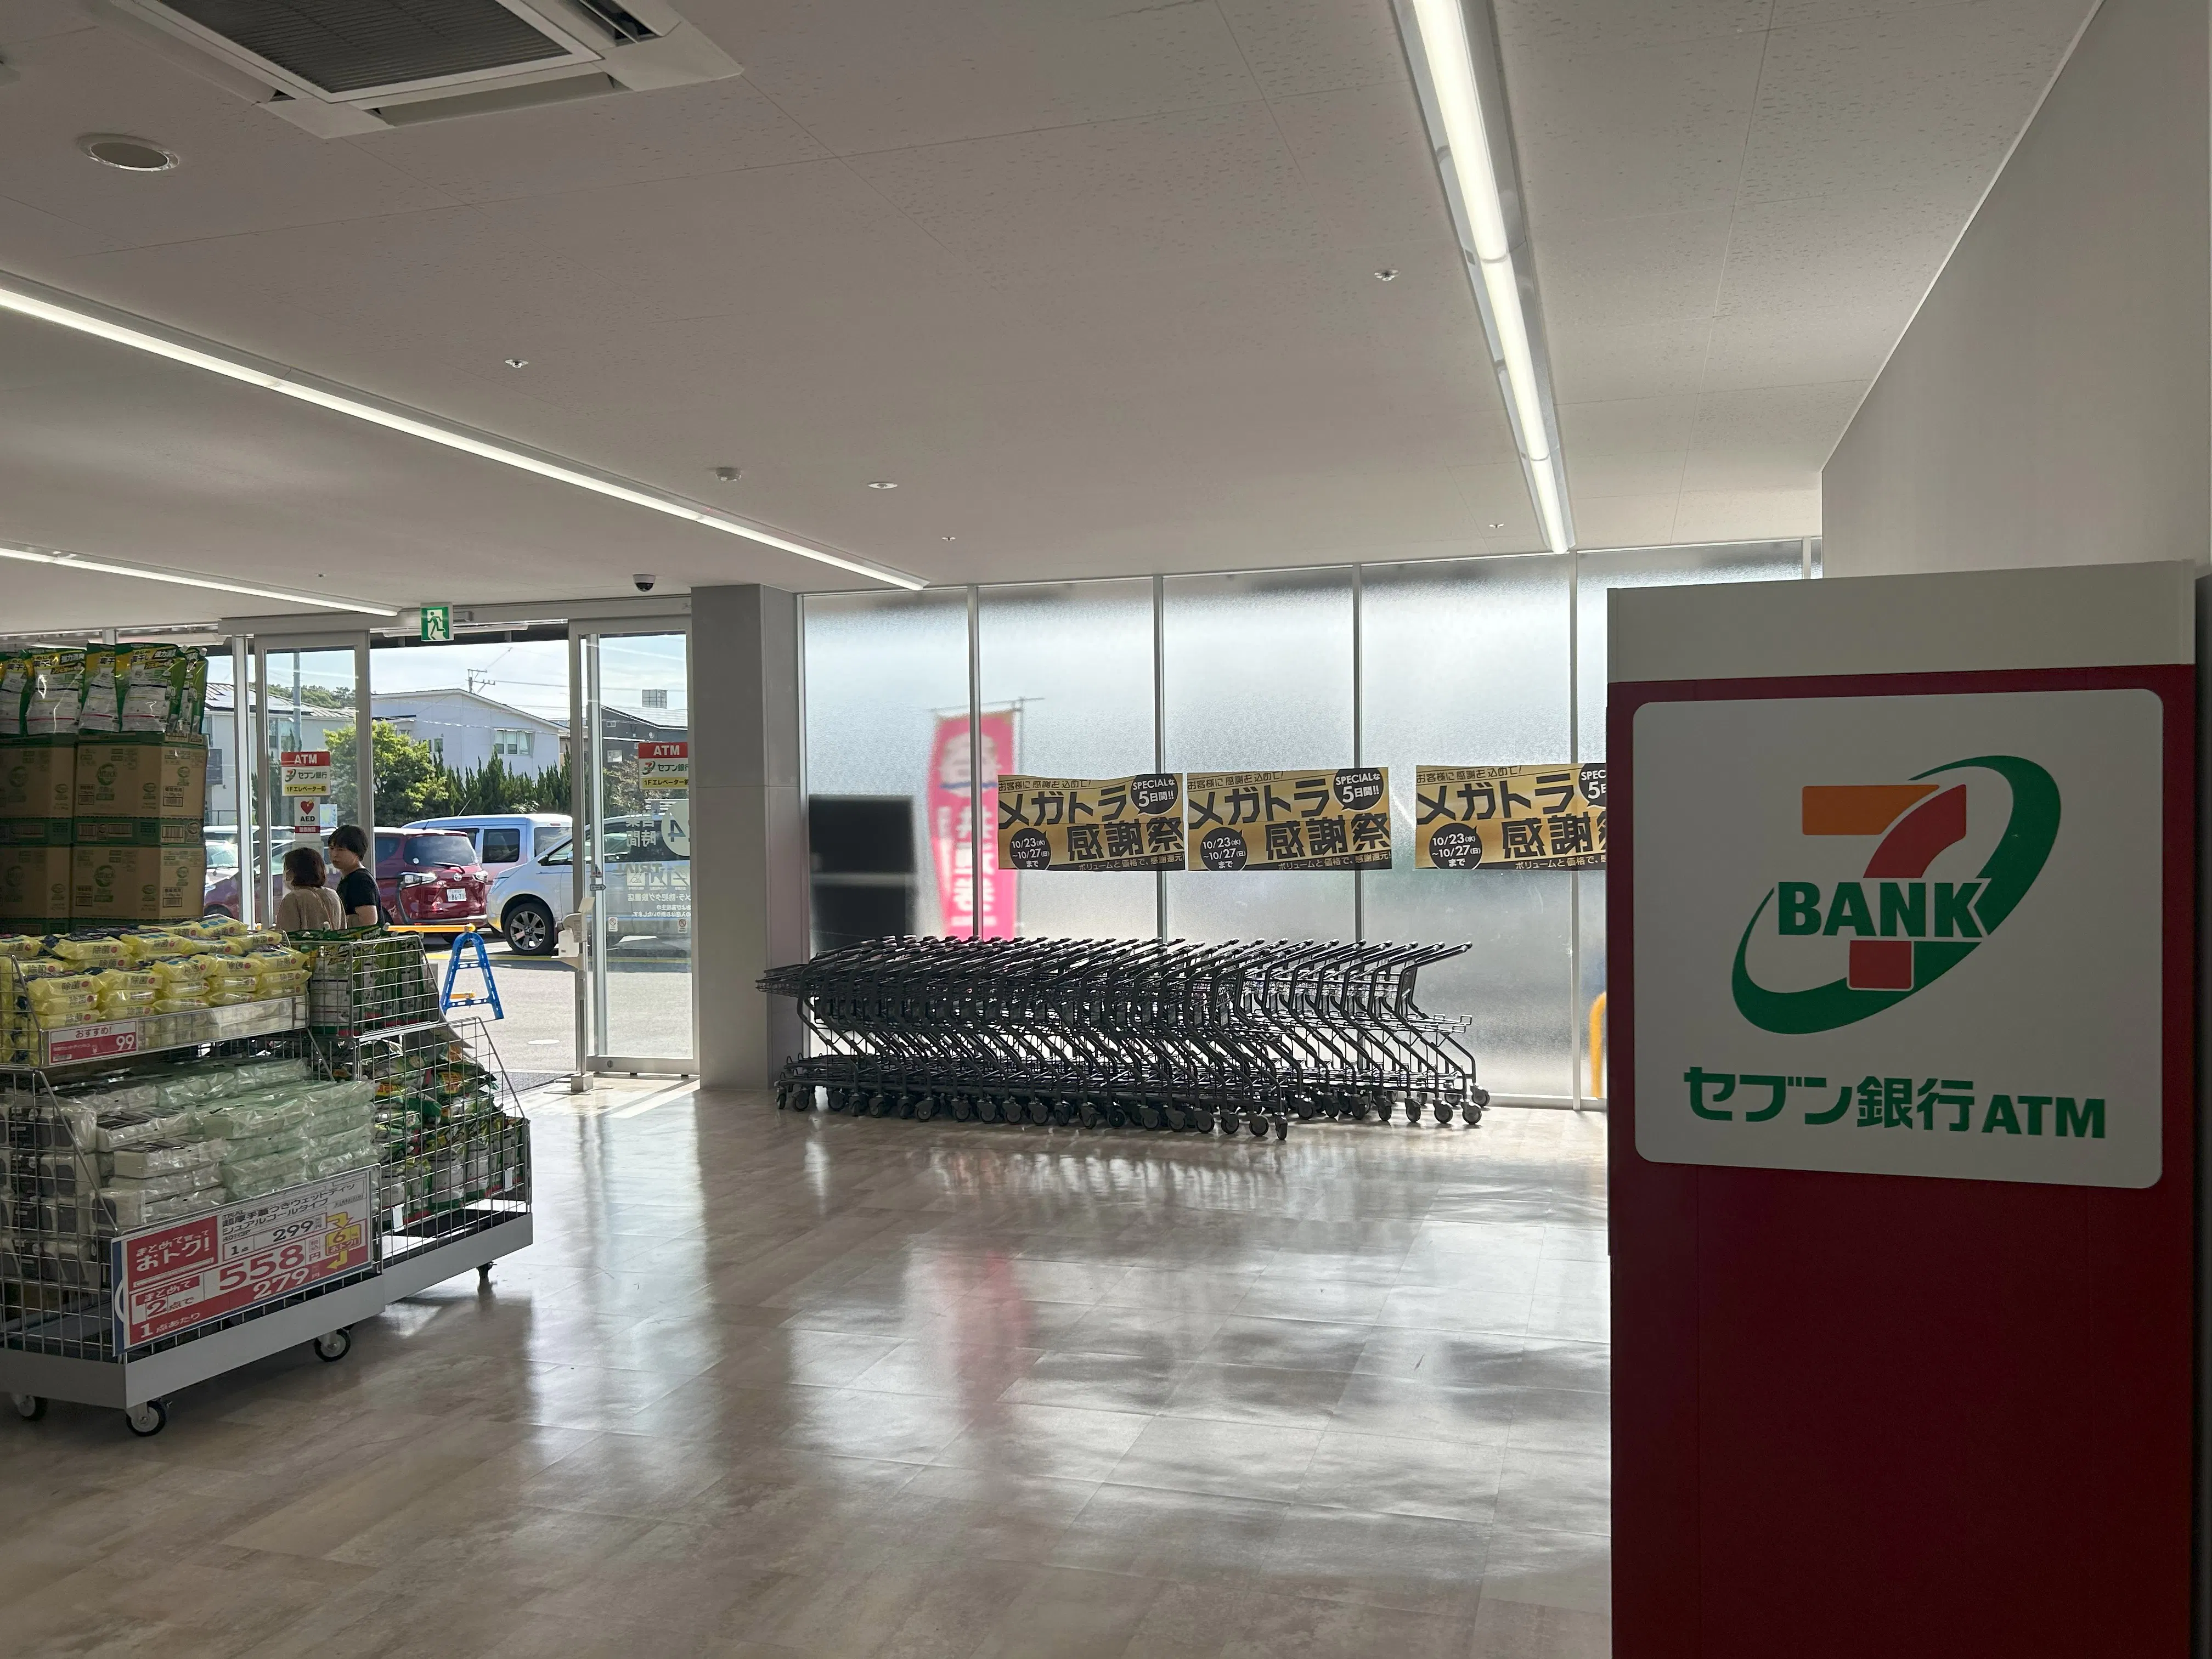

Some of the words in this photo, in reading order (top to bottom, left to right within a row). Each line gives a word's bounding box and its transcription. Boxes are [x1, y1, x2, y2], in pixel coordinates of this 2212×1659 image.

[653, 745, 680, 756] ATM
[294, 754, 317, 764] ATM
[298, 771, 328, 780] セブン銀行
[1335, 773, 1381, 786] SPECIALな
[1133, 778, 1175, 791] SPECIALな
[1138, 791, 1174, 808] 5日間!!
[1342, 785, 1380, 803] 5日間!!
[1417, 773, 1575, 826] メガトラ
[999, 785, 1127, 830] メガトラ
[1189, 778, 1329, 830] メガトラ
[1012, 837, 1046, 849] 10/23(水)
[1066, 816, 1185, 861] 感謝祭
[1203, 836, 1241, 850] 10/23(水)
[1265, 812, 1391, 861] 感謝祭
[1432, 833, 1476, 847] 10/23(水)
[1501, 810, 1607, 860] 感謝
[1026, 860, 1039, 868] まで
[1218, 861, 1233, 869] まで
[1448, 858, 1466, 867] まで
[1777, 880, 1983, 939] BANK
[76, 1026, 111, 1039] おすすめ!
[116, 1034, 134, 1050] 99
[222, 1210, 246, 1218] TRIAL
[273, 1220, 313, 1243] 299
[333, 1231, 346, 1243] 6
[136, 1229, 209, 1257] まとめて買って
[137, 1237, 210, 1272] おトク!
[219, 1244, 305, 1290] 558
[144, 1280, 191, 1302] まとめて
[253, 1267, 309, 1300] 279
